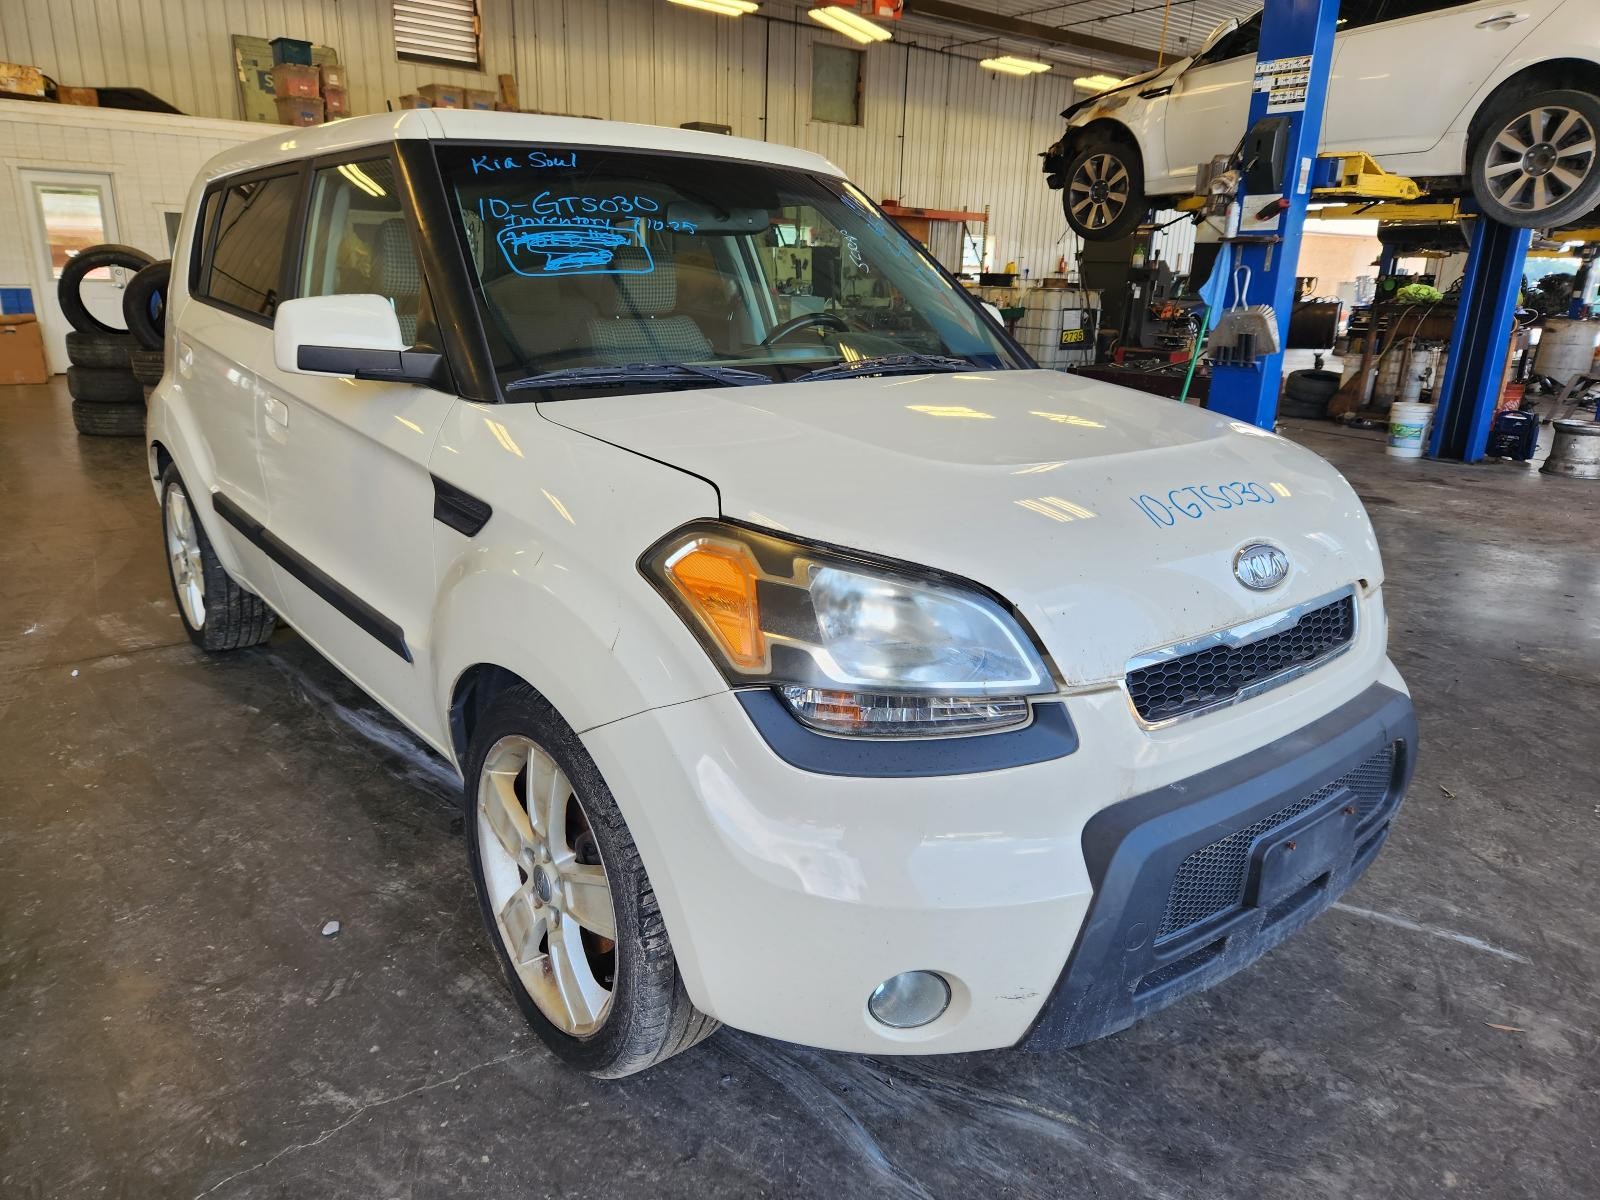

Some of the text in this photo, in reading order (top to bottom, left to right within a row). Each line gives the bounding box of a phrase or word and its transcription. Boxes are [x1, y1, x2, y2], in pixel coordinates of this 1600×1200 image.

[472, 152, 577, 174] Kia Soul
[503, 214, 610, 229] Inventory
[1063, 330, 1084, 343] 2735
[1128, 482, 1275, 529] 10-GTS030
